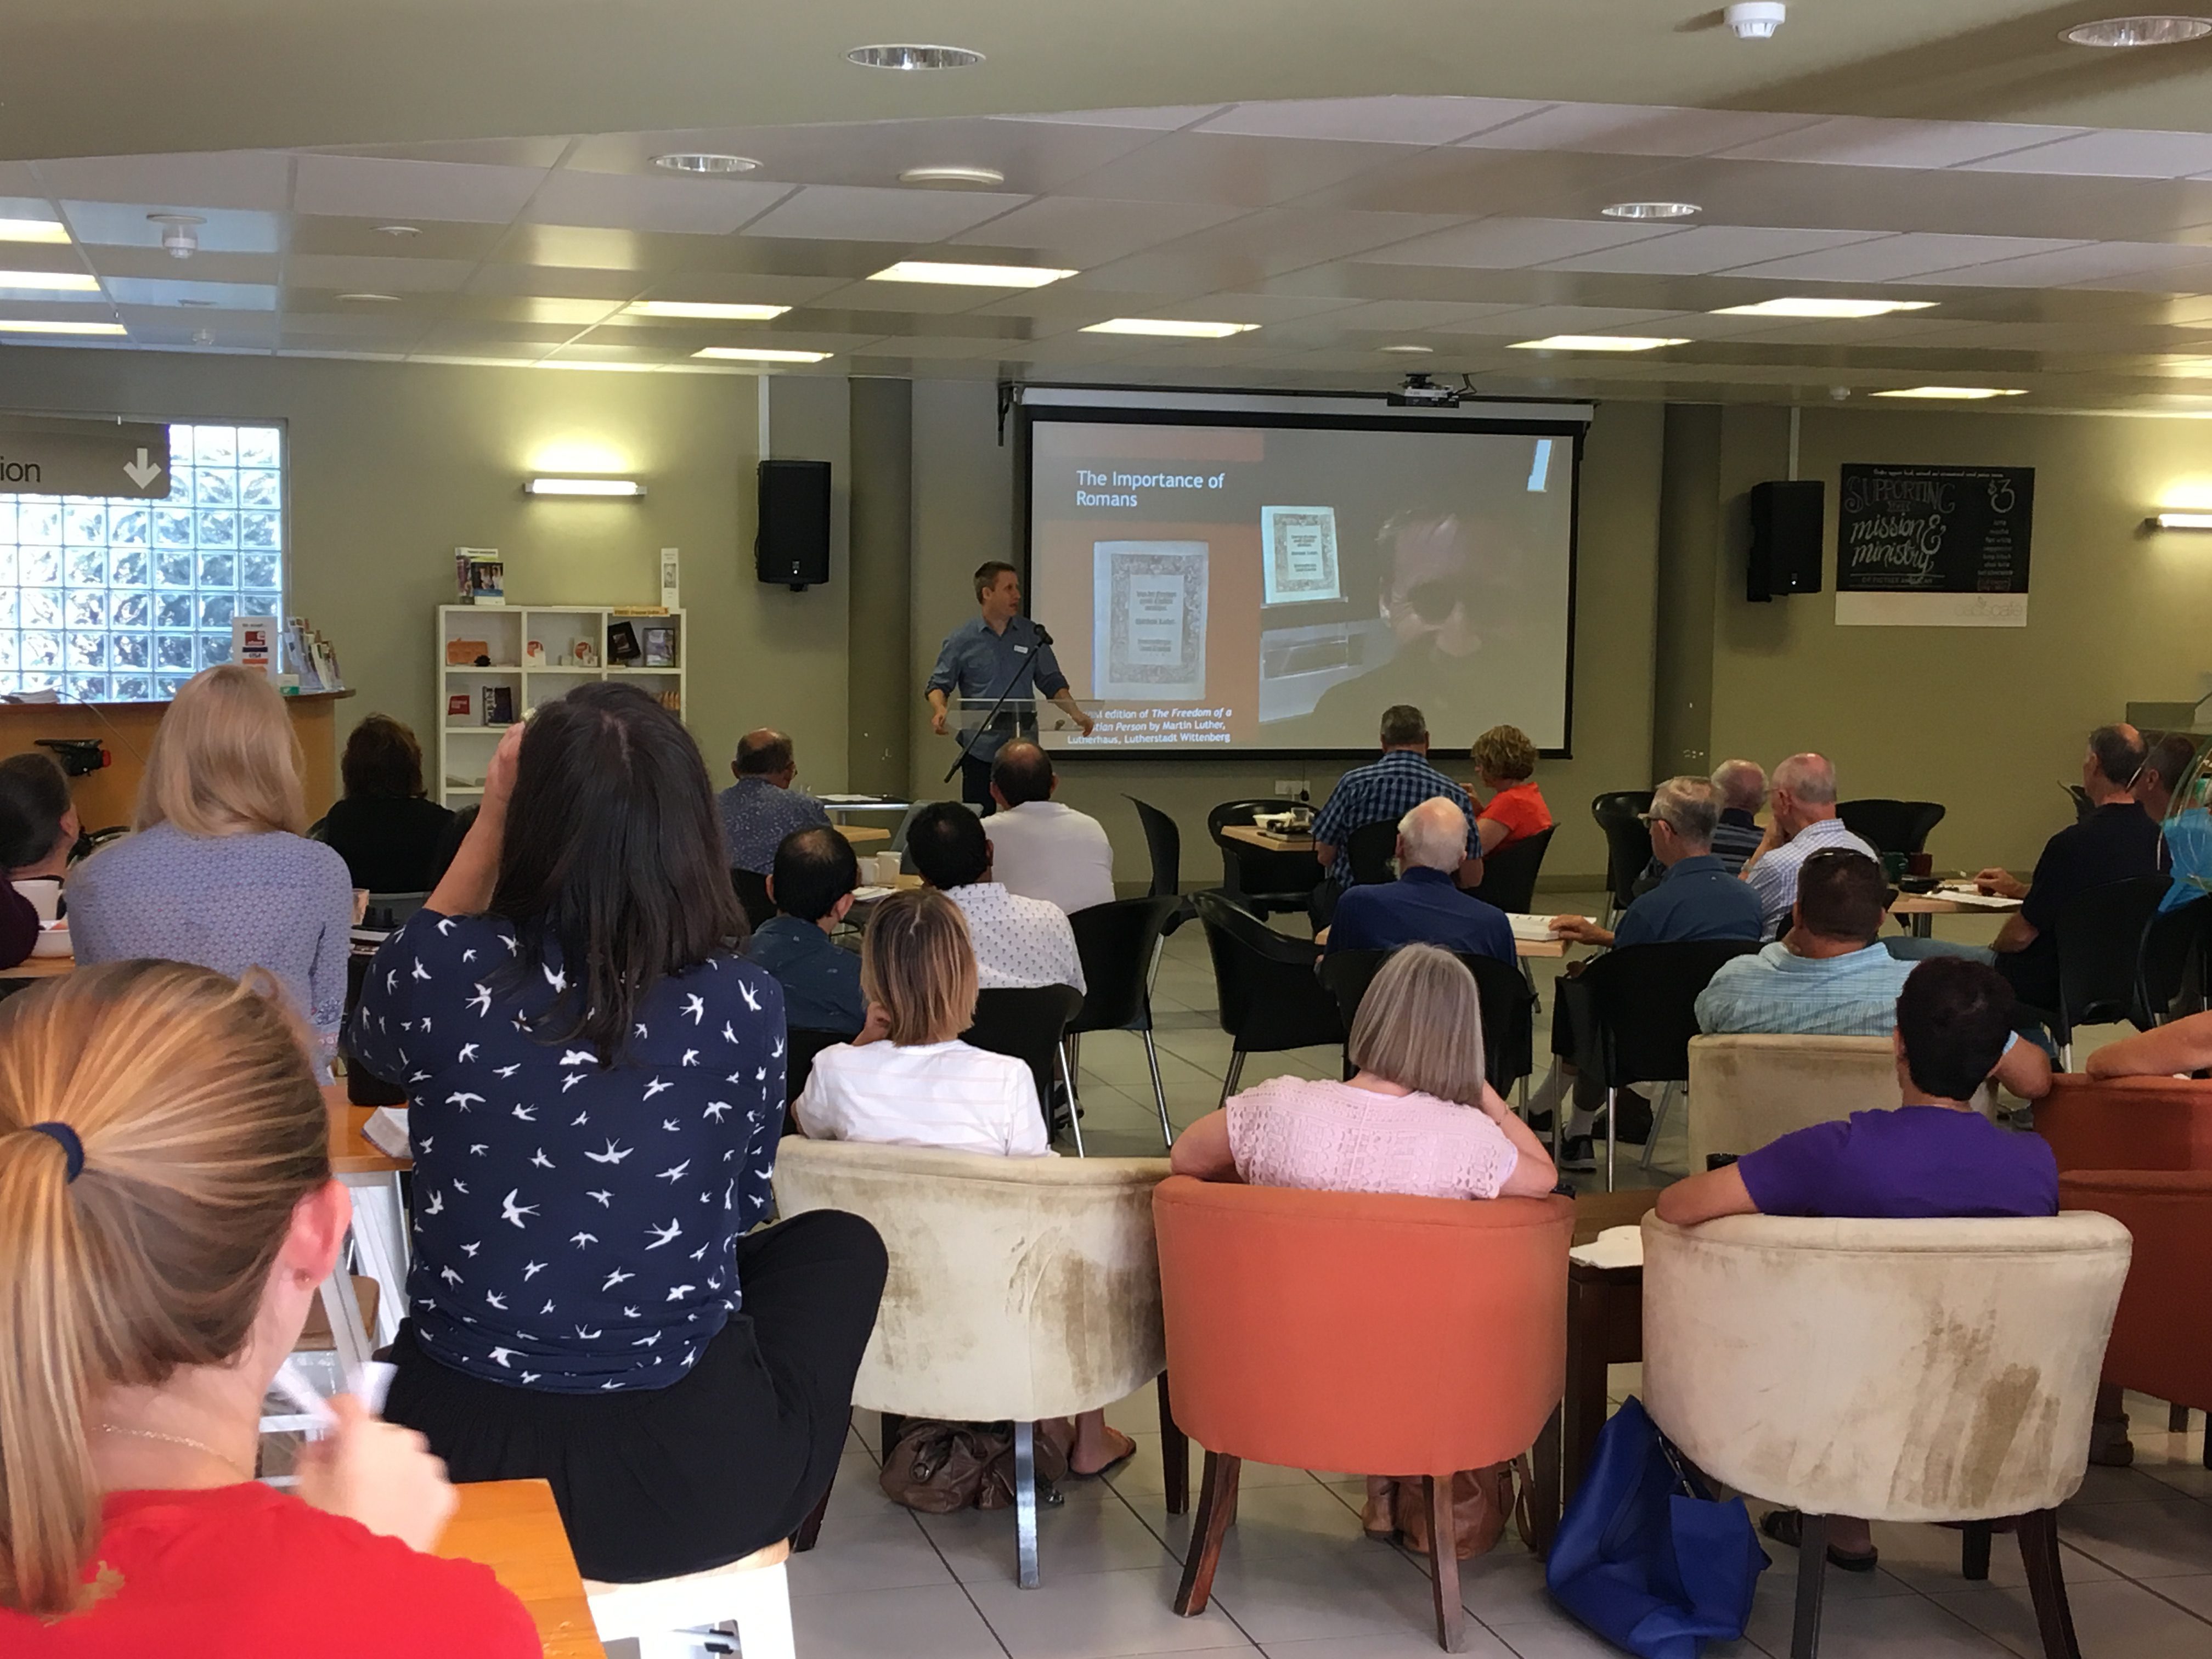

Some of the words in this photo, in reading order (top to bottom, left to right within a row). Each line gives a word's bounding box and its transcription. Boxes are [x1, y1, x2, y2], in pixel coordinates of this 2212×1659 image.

[1076, 470, 1107, 486] The
[1113, 471, 1204, 490] Importance
[1208, 473, 1226, 488] of
[1076, 490, 1138, 506] Romans
[1844, 476, 1956, 514] SUPPORTING
[1849, 512, 1925, 544] mission
[1851, 539, 1934, 575] ministry
[1105, 709, 1137, 718] edition
[1139, 709, 1149, 718] of
[1152, 708, 1169, 718] The
[1171, 708, 1211, 718] Freedom
[1213, 707, 1224, 718] of
[1225, 709, 1232, 717] a
[1115, 721, 1147, 731] Person
[1149, 721, 1160, 732] by
[1163, 721, 1192, 730] Martin
[1194, 720, 1226, 730] Luther,
[1125, 733, 1178, 743] Lutherstadt
[1180, 732, 1231, 743] Wittenberg
